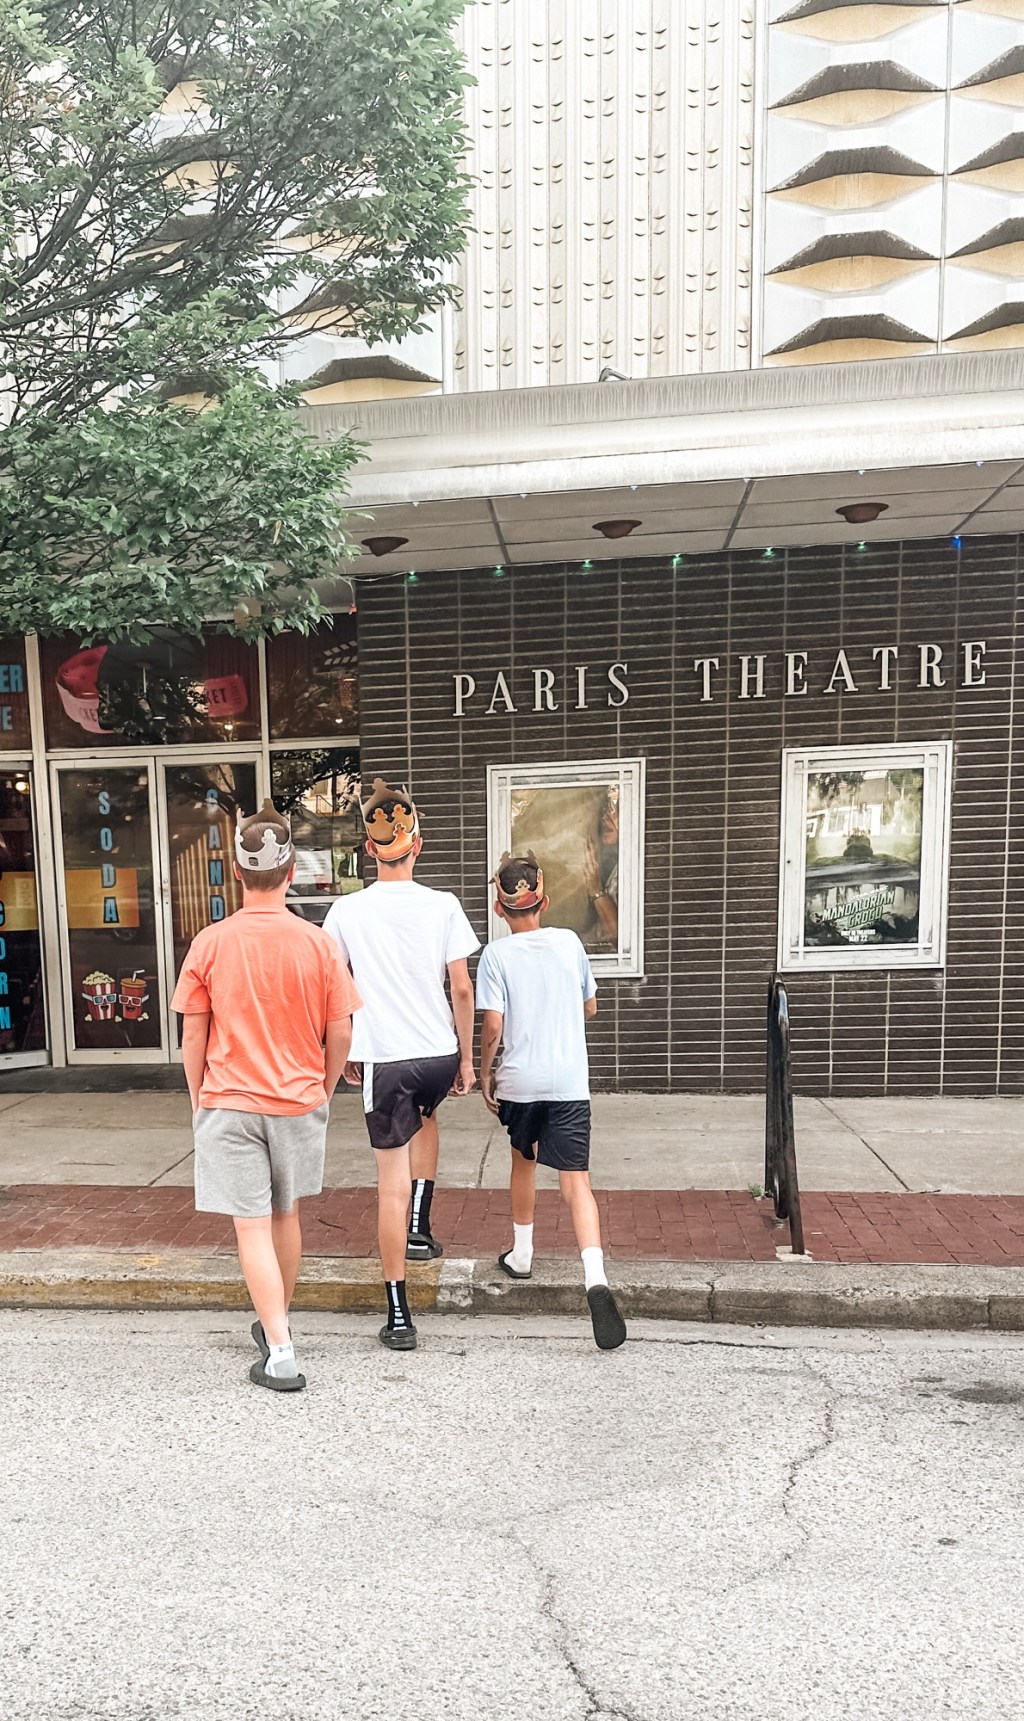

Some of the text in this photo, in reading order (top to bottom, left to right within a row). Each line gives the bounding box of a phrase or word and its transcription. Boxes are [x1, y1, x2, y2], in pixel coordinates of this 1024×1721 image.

[453, 640, 987, 716] PARIS THEATRE
[98, 791, 119, 923] SODA
[822, 890, 895, 921] MANDALORIAN
[846, 906, 883, 929] GROGU
